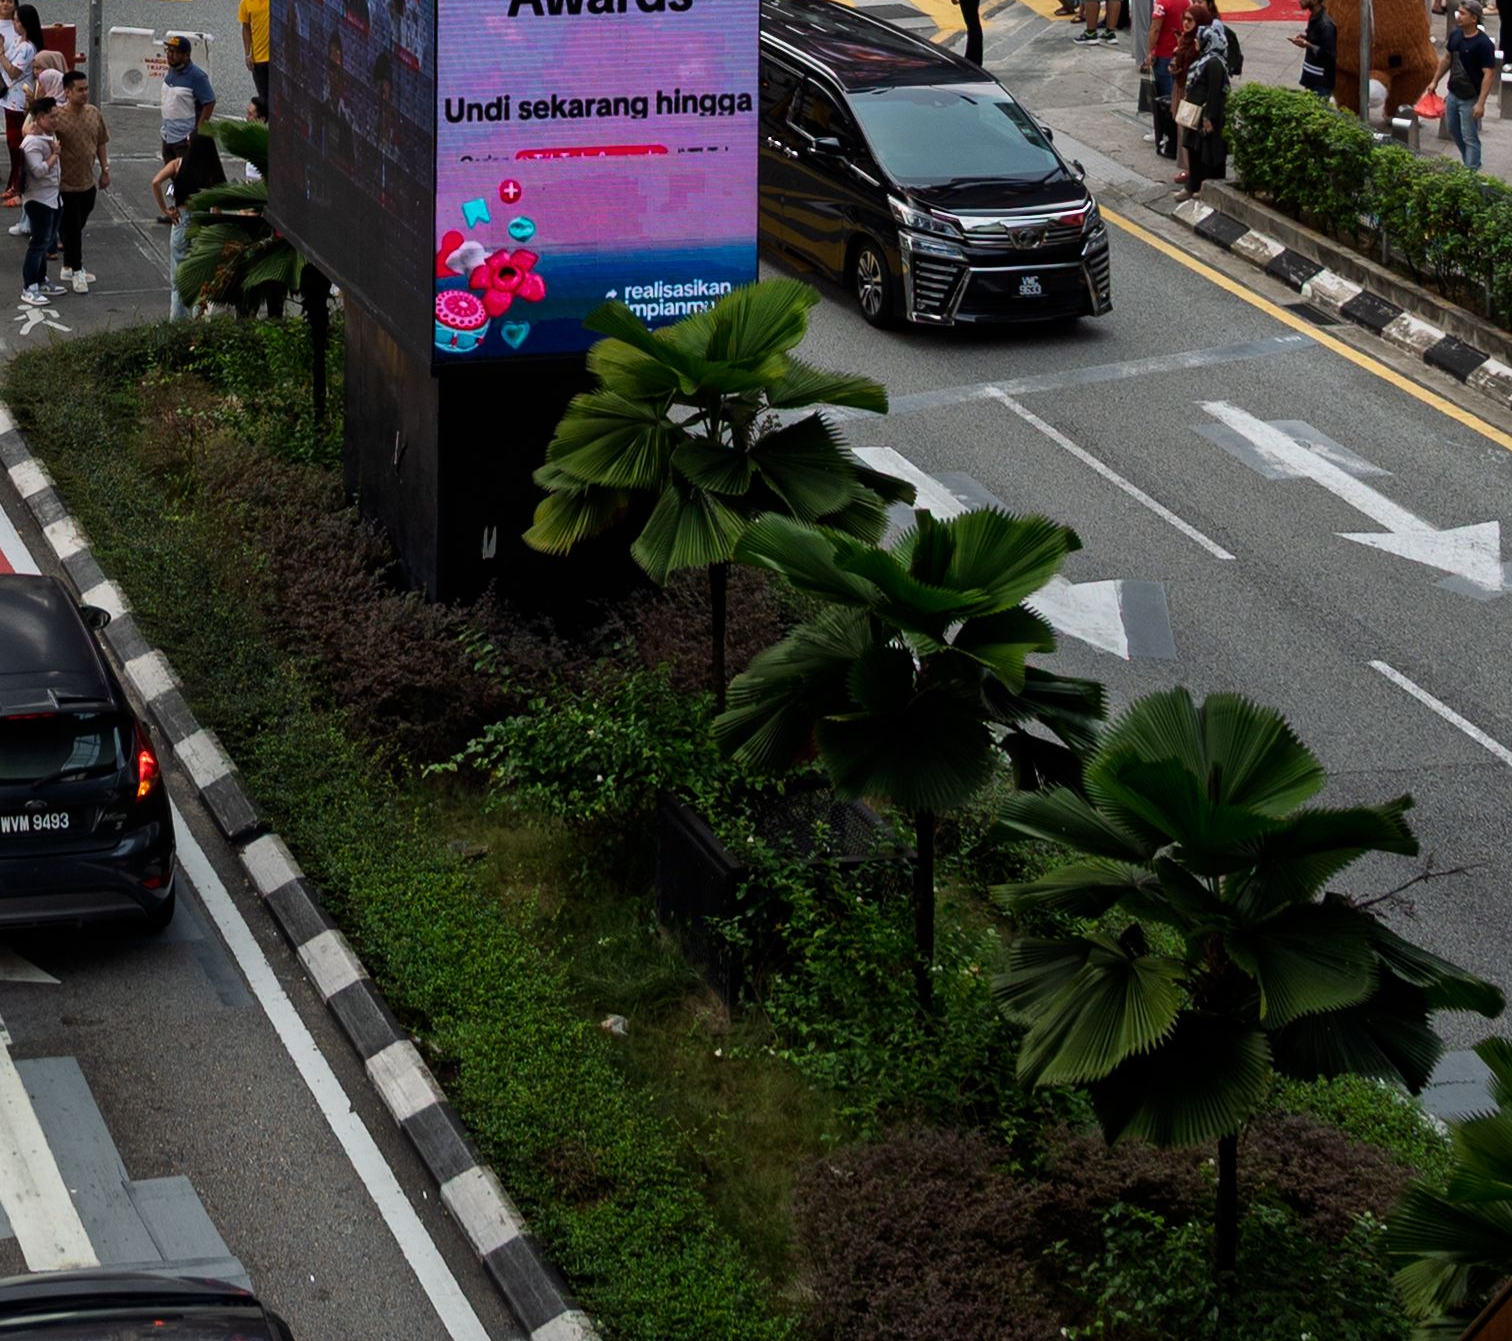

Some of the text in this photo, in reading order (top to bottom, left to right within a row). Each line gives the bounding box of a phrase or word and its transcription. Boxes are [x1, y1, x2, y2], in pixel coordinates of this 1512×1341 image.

[444, 88, 753, 124] Undi sekarang hingga
[625, 280, 732, 299] realisasikan
[0, 812, 70, 834] WVM 9493
